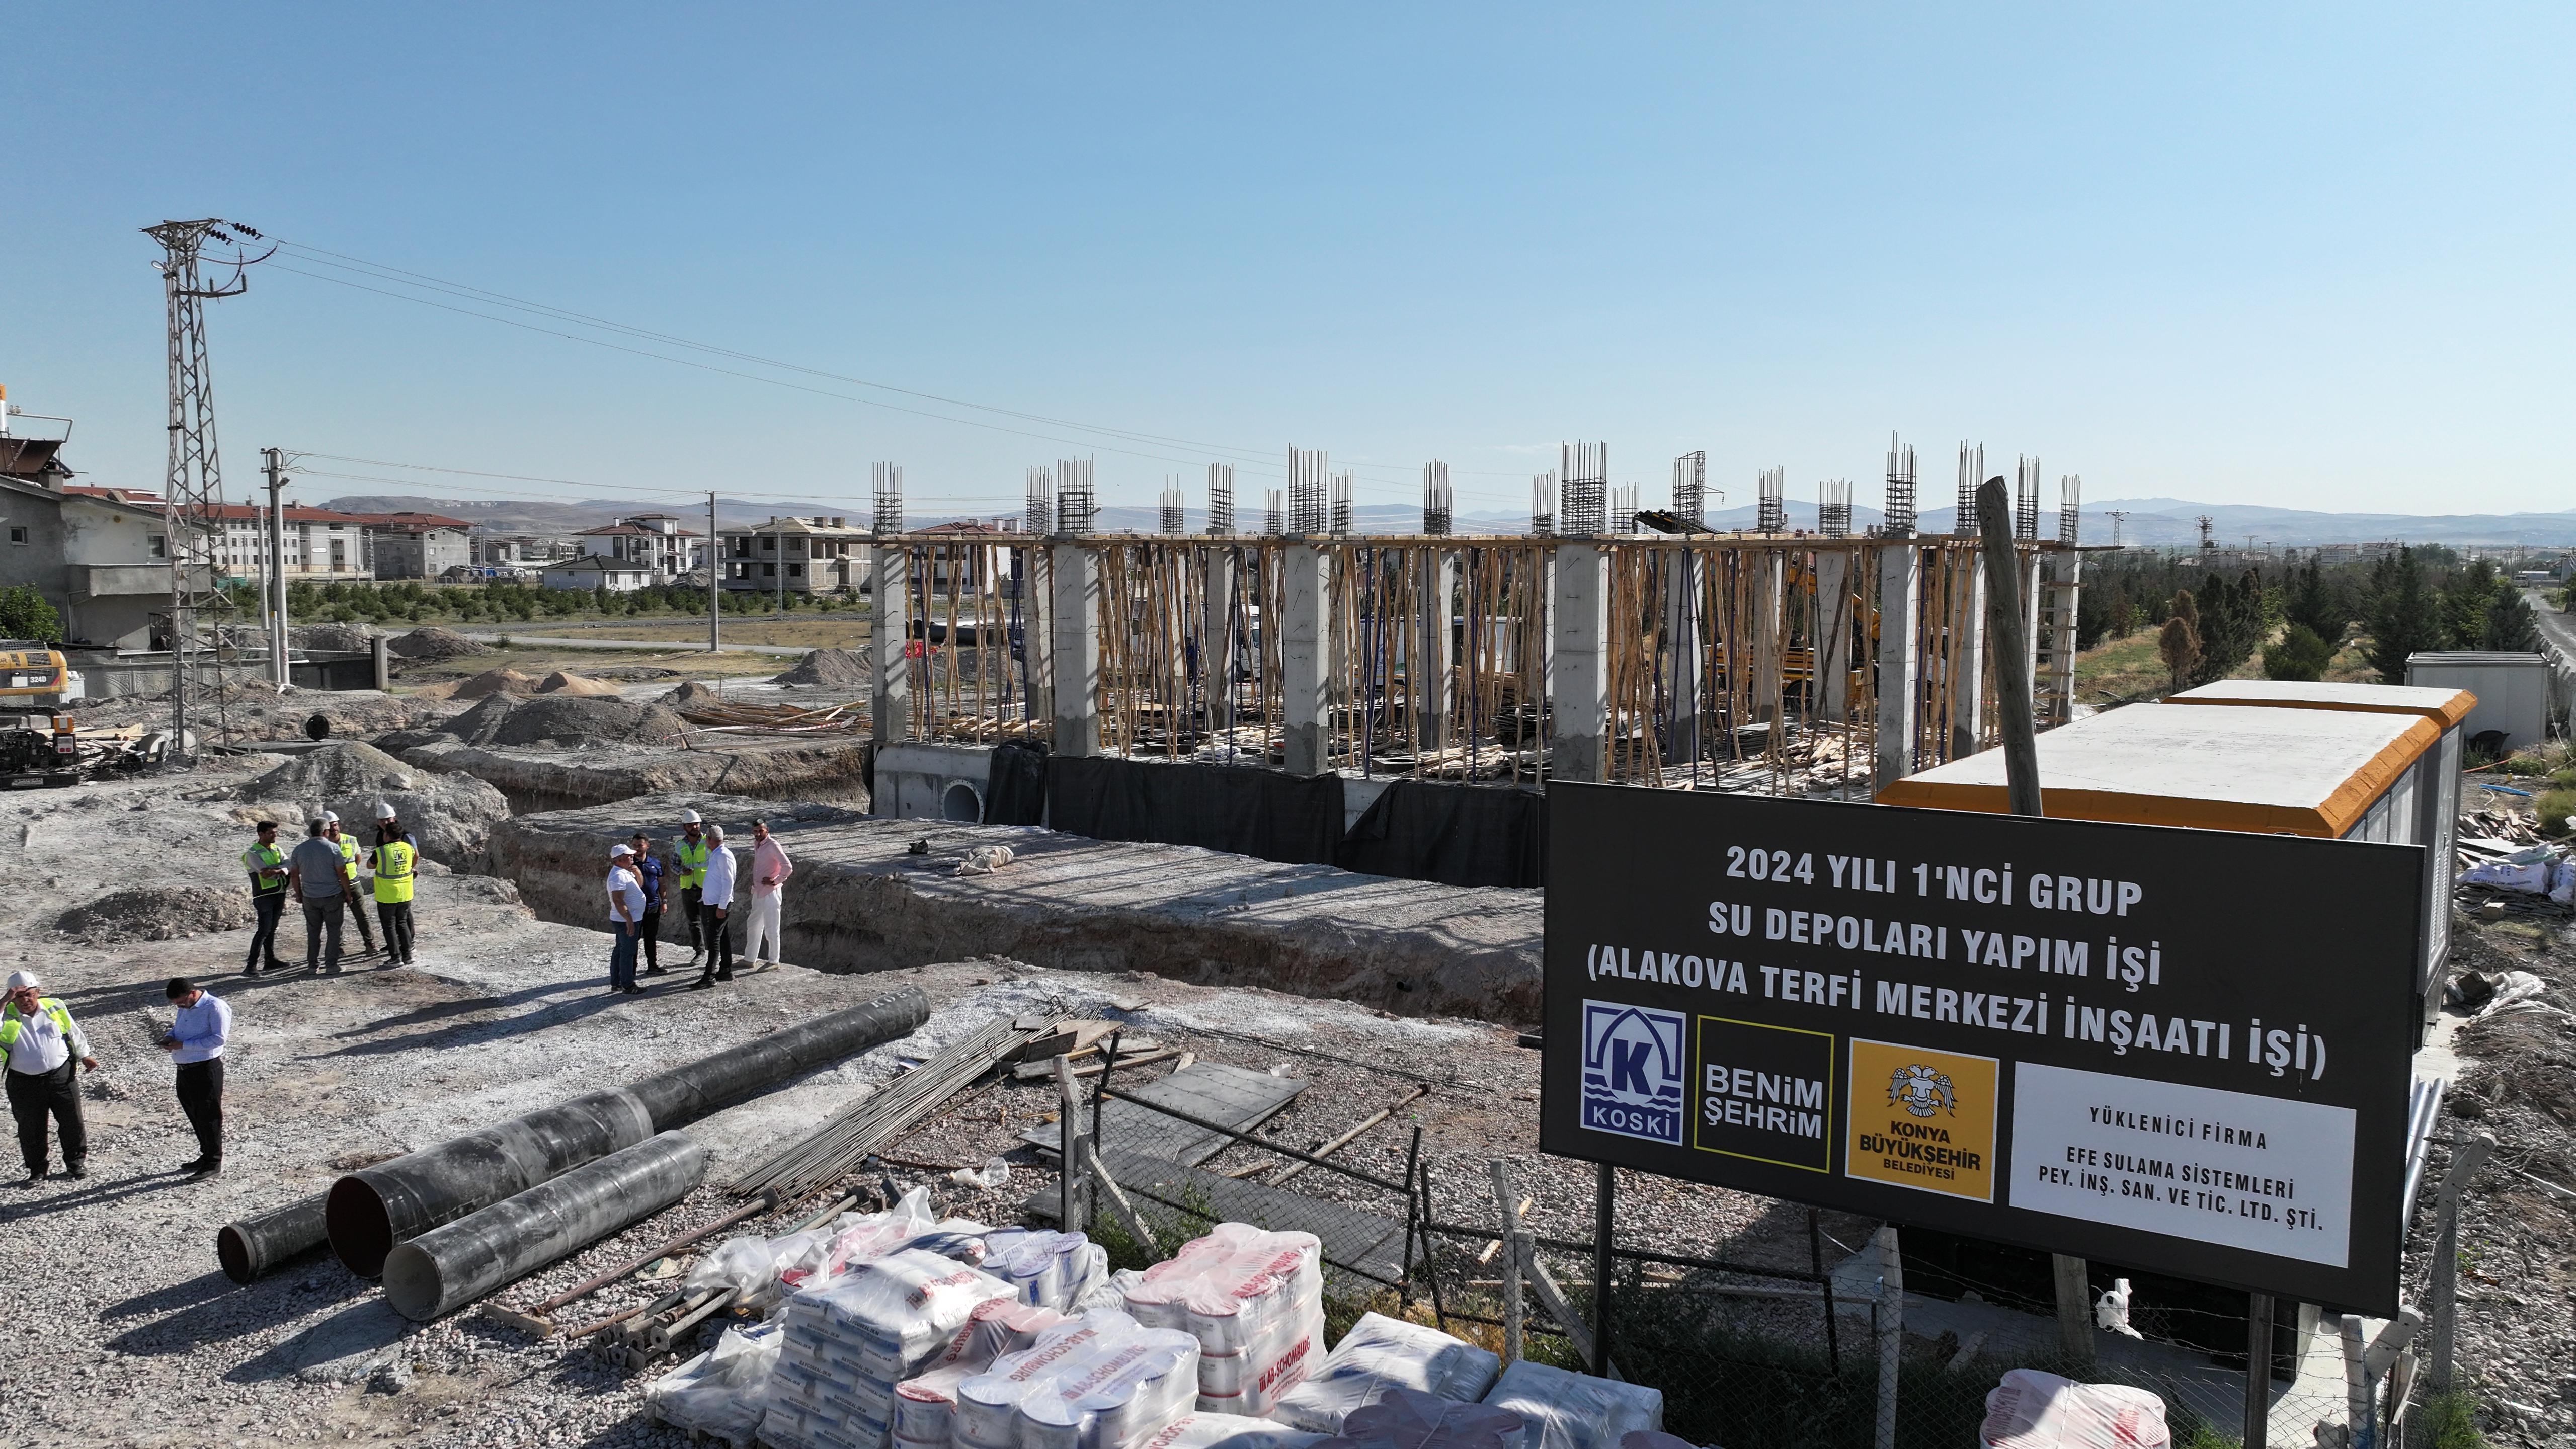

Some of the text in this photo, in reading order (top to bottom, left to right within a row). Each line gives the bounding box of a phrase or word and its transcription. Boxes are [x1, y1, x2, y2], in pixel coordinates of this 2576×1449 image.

[1727, 846, 2141, 916] 2024 YILI 1'NCİ GRUP
[1709, 902, 2159, 992] SU DEPOLARI YAPIM İŞİ
[1588, 944, 2325, 1080] (ALAKOVA TERFİ MERKEZİ İNŞAATI İŞİ)
[1593, 1106, 1670, 1136] KOSKİ
[1891, 1120, 1951, 1144] KONYA
[2090, 1105, 2266, 1150] YÜKLENİCİ FİRMA
[1860, 1133, 1980, 1171] BÜYÜKŞEHİR
[1883, 1158, 1955, 1180] BELEDİYESİ
[2066, 1146, 2293, 1200] EFE SULAMA SİSTEMLERİ
[2039, 1165, 2323, 1231] PEY. İNŞ. SAN. VE TİC. LTD. ŞTİ.
